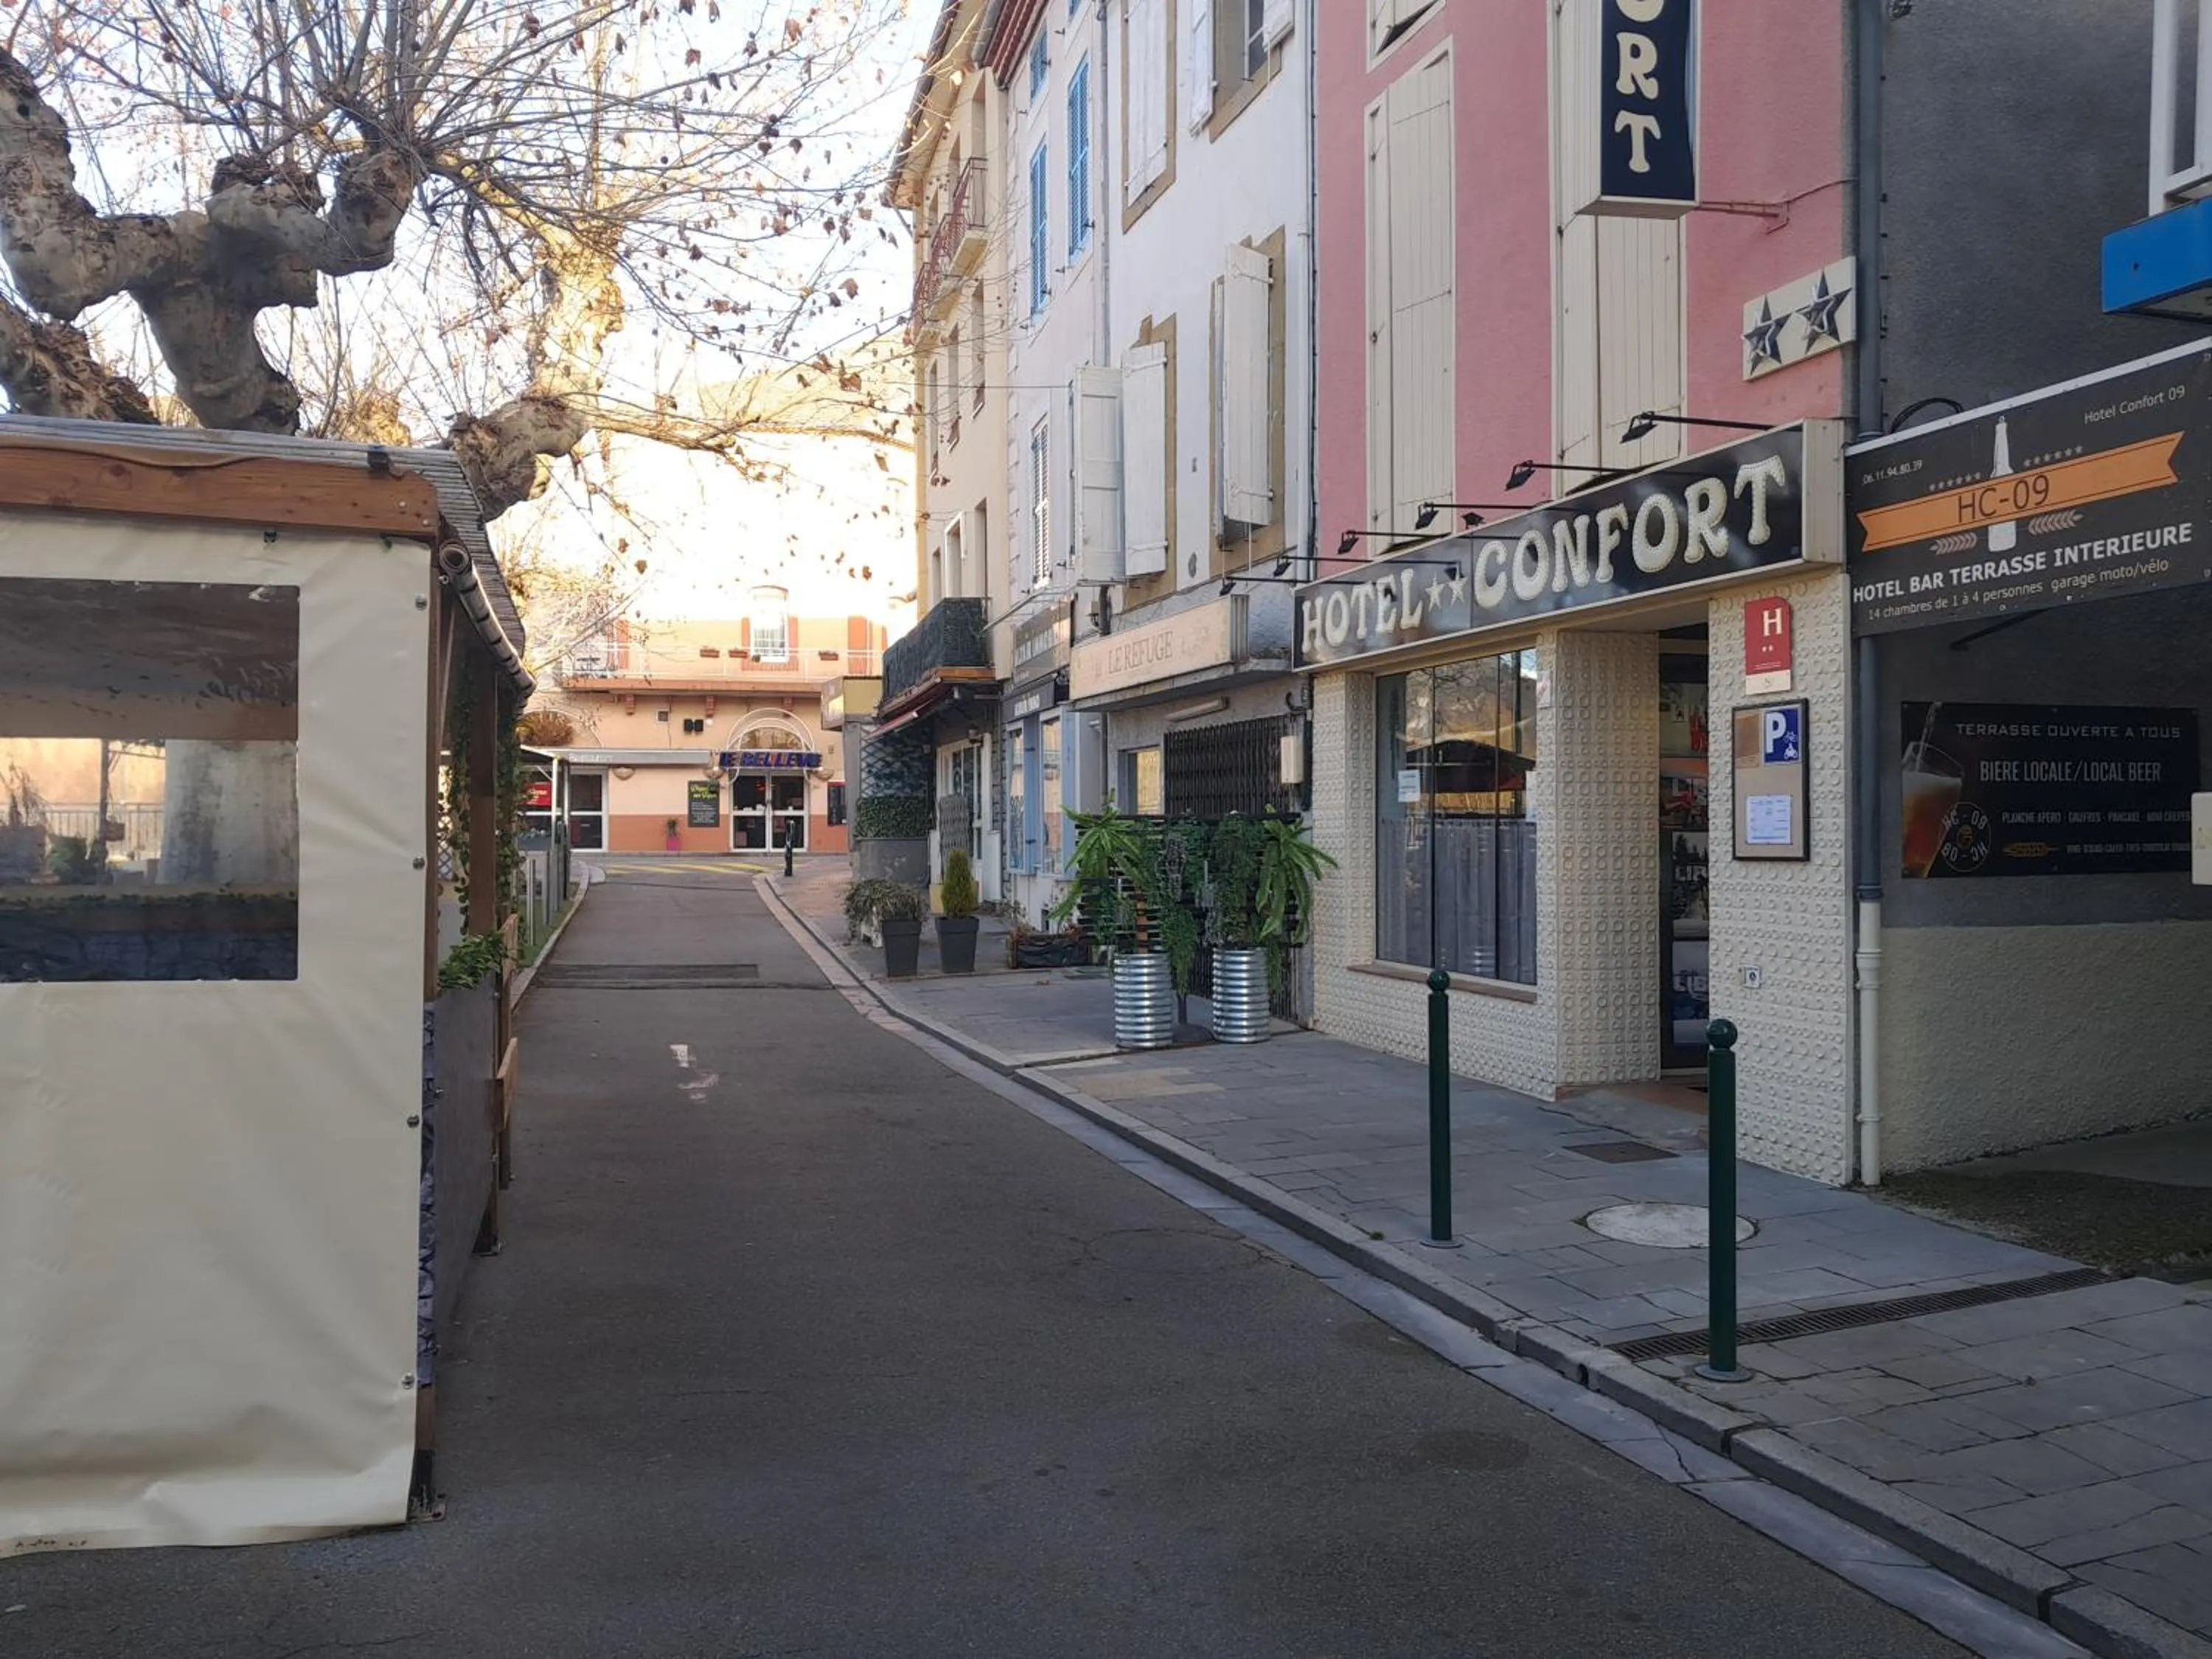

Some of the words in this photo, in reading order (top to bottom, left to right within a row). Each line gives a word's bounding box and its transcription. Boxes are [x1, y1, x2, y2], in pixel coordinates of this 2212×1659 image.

[2084, 404, 2116, 425] Hotel
[2119, 392, 2165, 415] Confort
[2168, 385, 2185, 403] 09
[1957, 474, 2051, 524] HC-09
[1301, 568, 1427, 653] HOTEL
[1474, 454, 1786, 609] CONFORT
[1853, 578, 1905, 602] HOTEL
[1910, 571, 1944, 594] BAR
[1949, 552, 2047, 587] TERRASSE
[2053, 523, 2193, 567] INTERIEURE
[1868, 608, 1882, 620] 14
[1883, 598, 1933, 618] chambres
[1935, 597, 1949, 611] de
[1952, 597, 1958, 608] 1
[1962, 591, 1969, 605] à
[1972, 591, 1980, 602] 4
[1983, 582, 2043, 605] personnes
[2051, 571, 2097, 592] garage
[1763, 608, 1782, 637] H
[1108, 647, 1121, 675] LE
[1124, 630, 1173, 671] REFUGE
[1766, 711, 1786, 754] P
[1955, 723, 2042, 737] TERRASSE
[2047, 724, 2119, 737] OUVERTE
[2125, 726, 2135, 737] A
[2140, 726, 2181, 738] TOUS
[1980, 760, 2020, 782] BIERE
[2023, 760, 2124, 782] LOCALE/LOCAL
[2129, 762, 2162, 782] BEER
